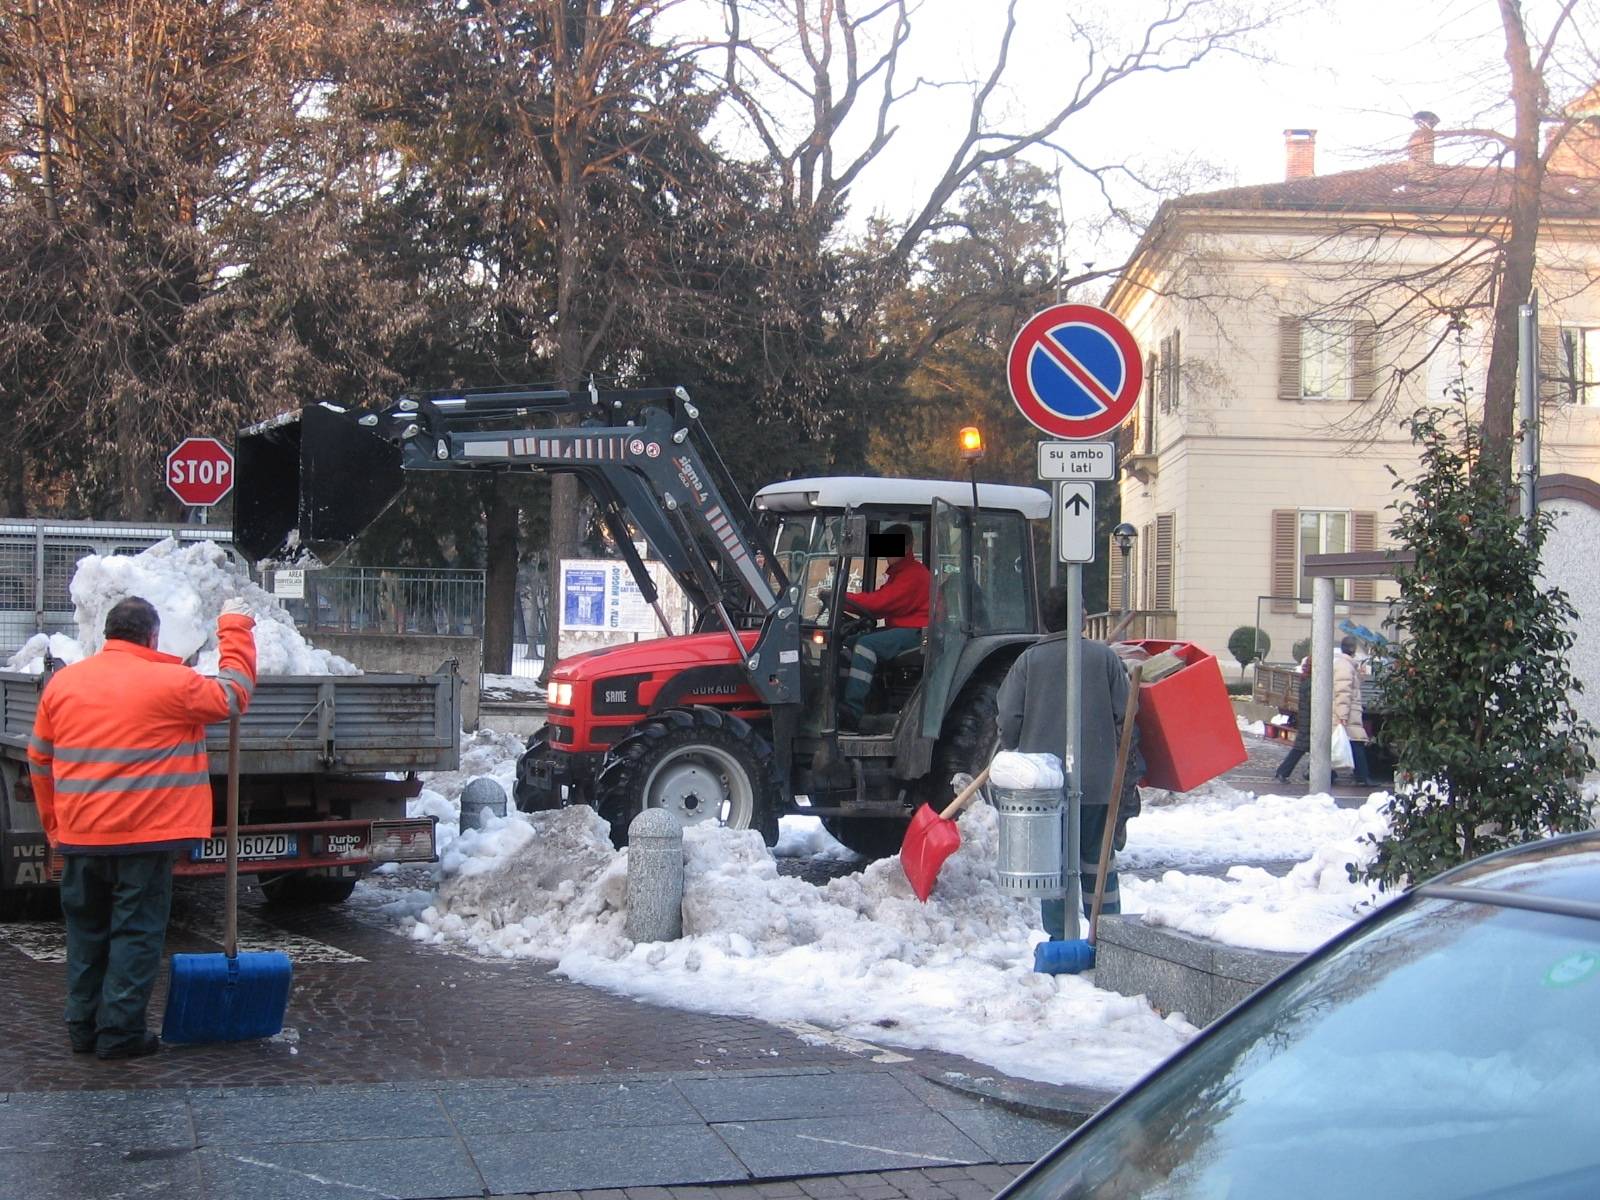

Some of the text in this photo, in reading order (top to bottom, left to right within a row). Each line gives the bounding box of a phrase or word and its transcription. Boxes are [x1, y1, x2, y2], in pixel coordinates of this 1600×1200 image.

[1049, 448, 1104, 459] su ambo
[171, 459, 229, 485] STOP
[678, 455, 703, 491] sigma
[1061, 462, 1092, 473] i lati
[605, 690, 627, 703] SAME
[328, 834, 361, 844] Turbo
[328, 843, 355, 853] Daily
